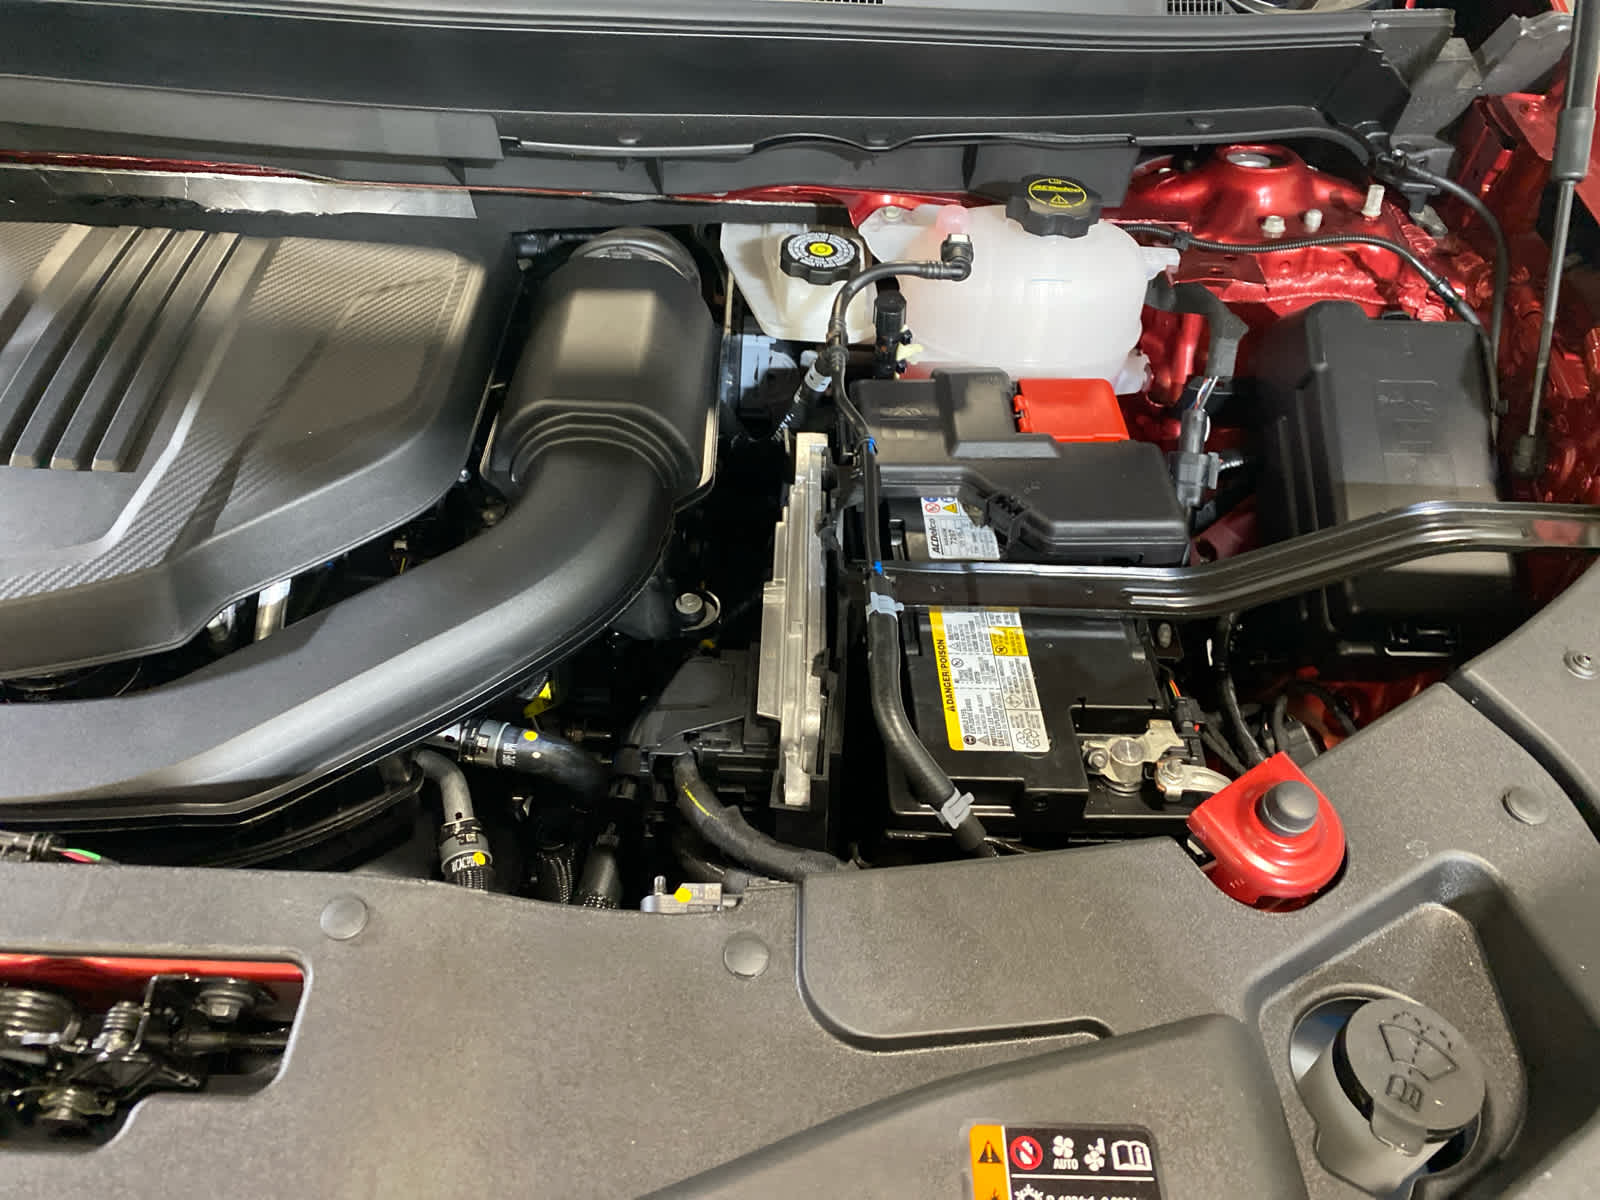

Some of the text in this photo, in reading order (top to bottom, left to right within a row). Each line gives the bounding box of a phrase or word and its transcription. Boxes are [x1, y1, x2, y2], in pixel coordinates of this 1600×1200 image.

[1031, 184, 1081, 193] ACDelco
[929, 518, 941, 554] ACDelco
[936, 639, 956, 706] DANGER/POISON
[1053, 1158, 1079, 1170] AUTO
